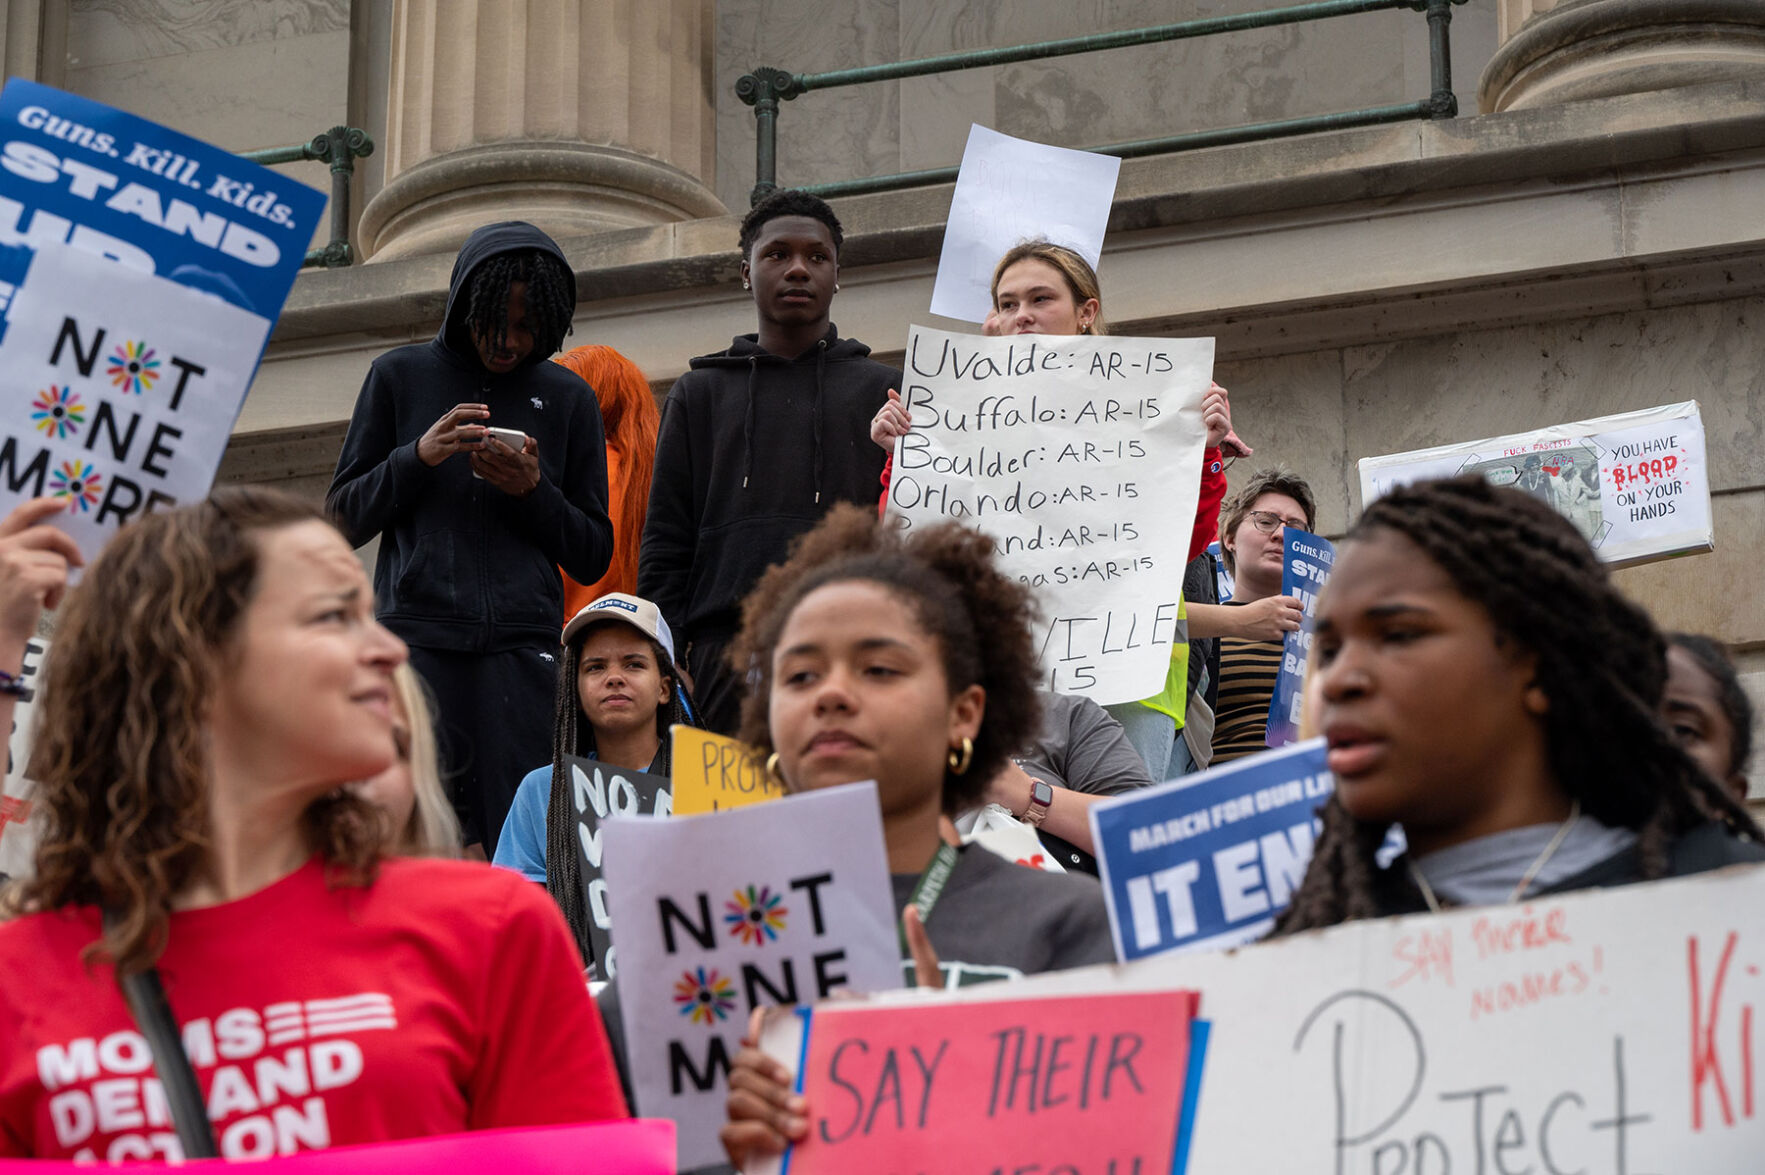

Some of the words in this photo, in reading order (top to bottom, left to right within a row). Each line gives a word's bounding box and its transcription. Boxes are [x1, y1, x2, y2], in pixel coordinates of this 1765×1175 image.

[17, 106, 119, 158] Guns.
[124, 142, 201, 189] Kill.
[206, 175, 296, 229] Kids.
[1, 141, 280, 268] STAND
[911, 334, 1074, 381] Uvalde:
[1089, 351, 1173, 380] AR-15
[906, 385, 1066, 432] Buffalo:
[1075, 398, 1160, 424] AR-15
[900, 432, 1045, 477] Boulder:
[1057, 440, 1146, 462] AR-15
[1503, 446, 1526, 458] FUCK
[1611, 443, 1640, 461] YOU
[1643, 435, 1679, 454] HAVE
[1616, 491, 1636, 507] ON
[1645, 480, 1683, 502] YOUR
[1630, 500, 1676, 523] HANDS
[1058, 522, 1139, 547] AR-15
[1291, 540, 1319, 559] Guns.
[1129, 808, 1211, 854] MARCH
[1210, 794, 1256, 828] FOR
[1254, 778, 1303, 813] OUR
[1126, 860, 1201, 950] IT
[817, 1038, 950, 1145] SAY
[986, 1025, 1146, 1118] THEIR
